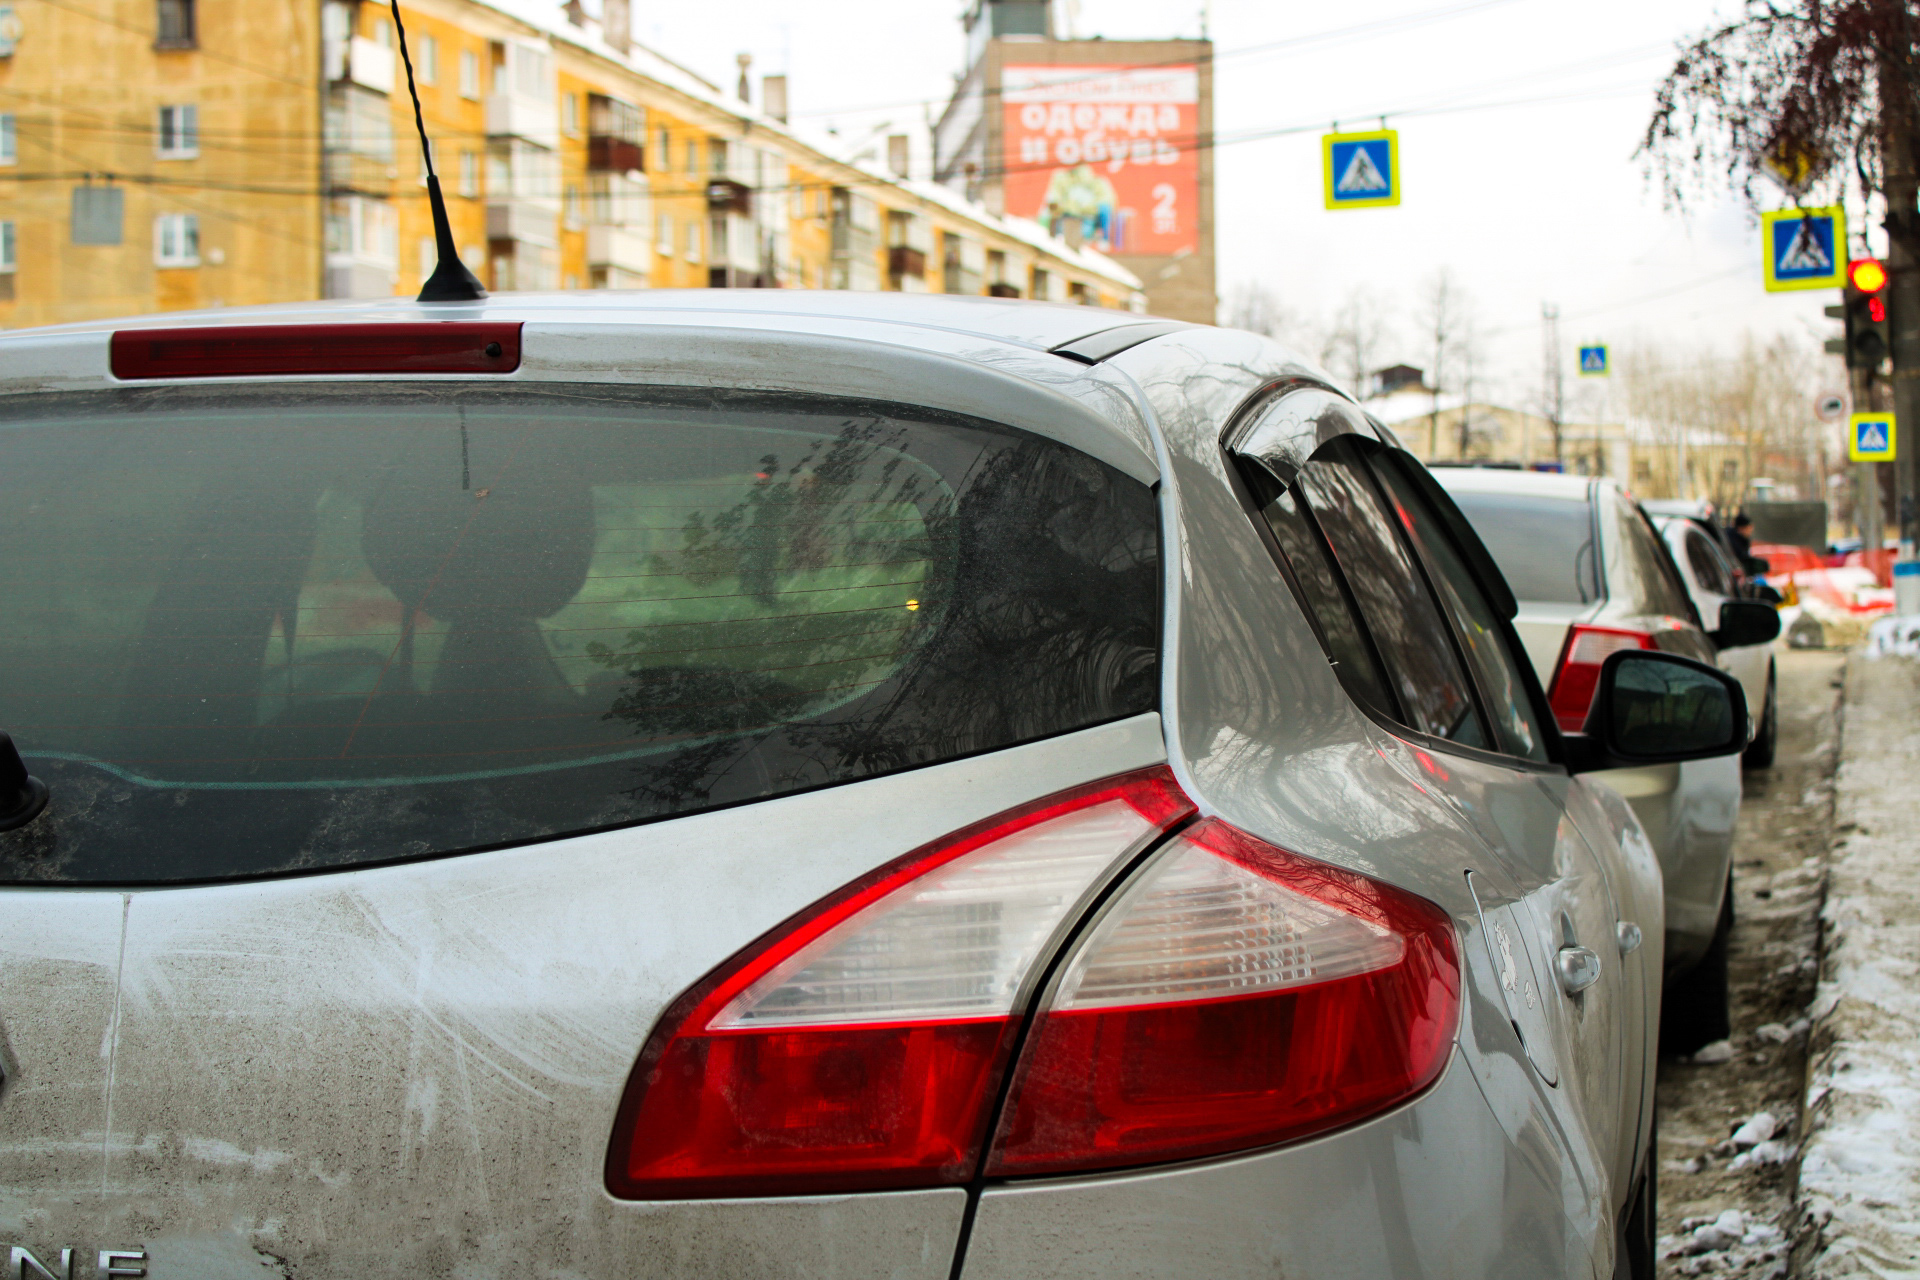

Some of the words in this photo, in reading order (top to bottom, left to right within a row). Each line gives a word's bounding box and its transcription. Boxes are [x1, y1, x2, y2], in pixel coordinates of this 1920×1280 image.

[1020, 103, 1180, 137] одежда
[1056, 131, 1180, 173] обувь
[1151, 181, 1178, 218] 2
